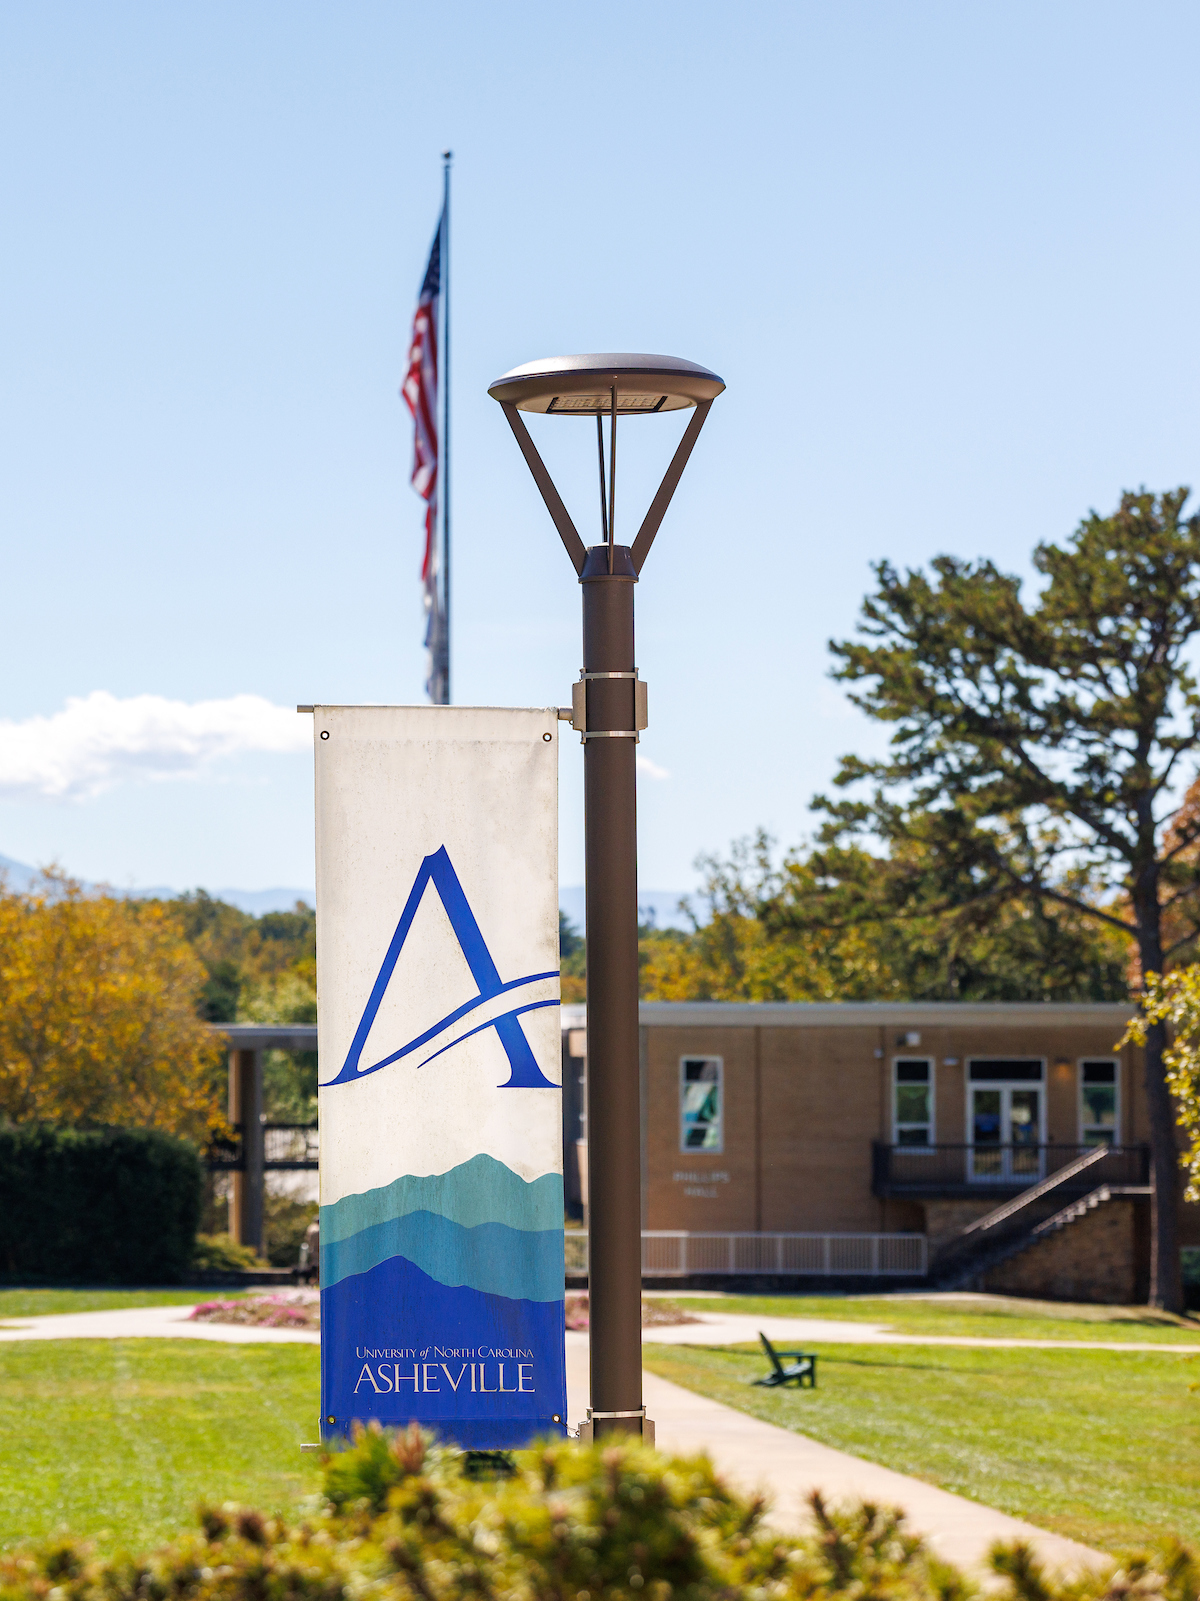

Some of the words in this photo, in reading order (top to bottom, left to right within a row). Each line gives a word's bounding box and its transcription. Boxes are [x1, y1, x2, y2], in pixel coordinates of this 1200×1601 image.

[318, 843, 563, 1089] A
[419, 1345, 432, 1360] of
[353, 1362, 536, 1394] ASHEVILLE
